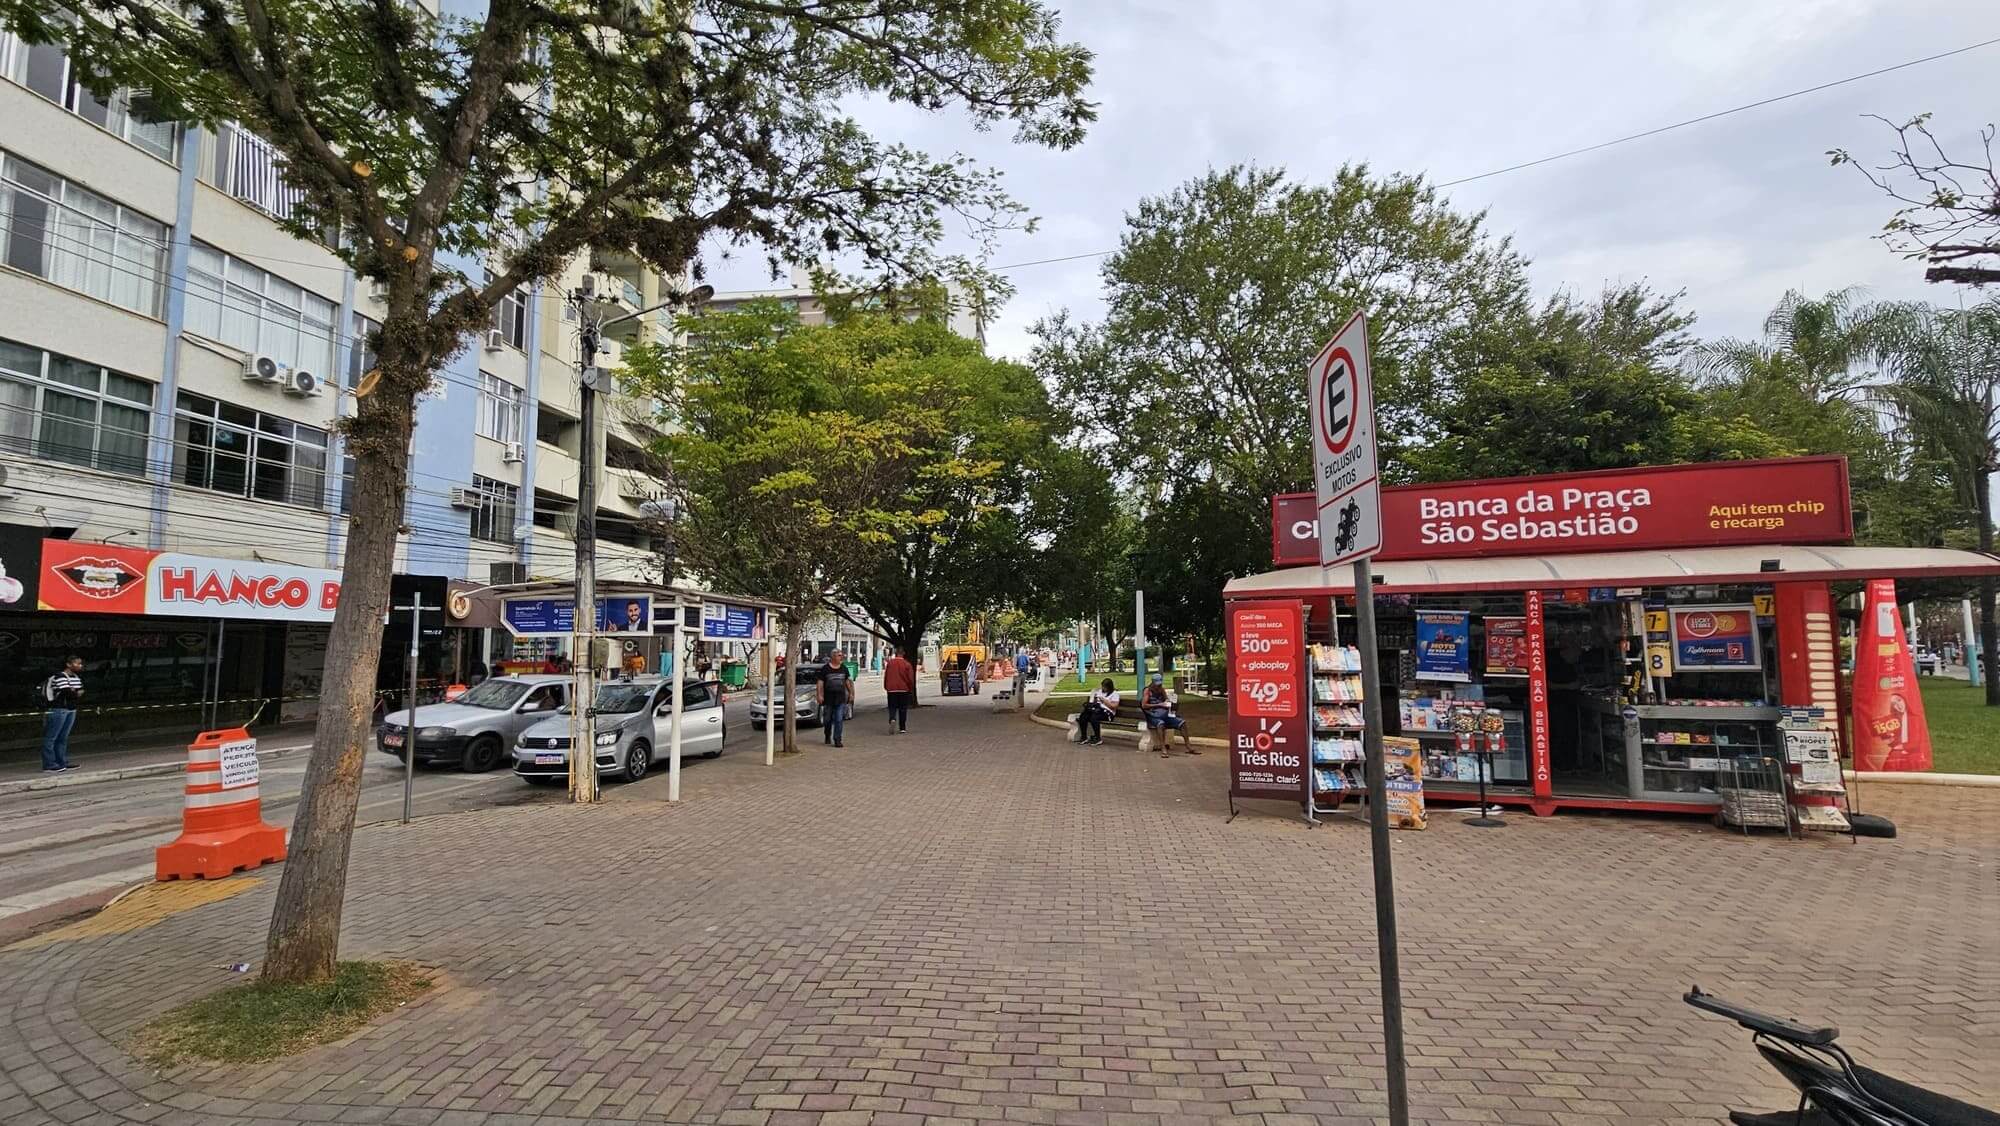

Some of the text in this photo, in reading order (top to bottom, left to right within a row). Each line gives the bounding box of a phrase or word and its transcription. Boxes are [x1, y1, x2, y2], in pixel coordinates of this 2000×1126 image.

[1328, 364, 1349, 436] E
[1325, 445, 1362, 480] EXCLUSIVO
[1332, 468, 1357, 493] MOTOS
[1420, 487, 1651, 520] Banca da Praça
[1709, 500, 1825, 518] Aqui tem chip
[1421, 512, 1639, 544] São Sebastião
[1710, 517, 1785, 530] e recarga
[159, 566, 311, 609] HANGO
[1241, 639, 1271, 653] 500
[1248, 661, 1290, 671] globoplay
[1652, 654, 1663, 670] 8
[1250, 682, 1279, 703] 49
[1238, 734, 1254, 748] Eu
[1535, 711, 1548, 780] SEBASTIÃO
[1238, 750, 1300, 767] Três Rios
[1277, 774, 1300, 784] Claro
